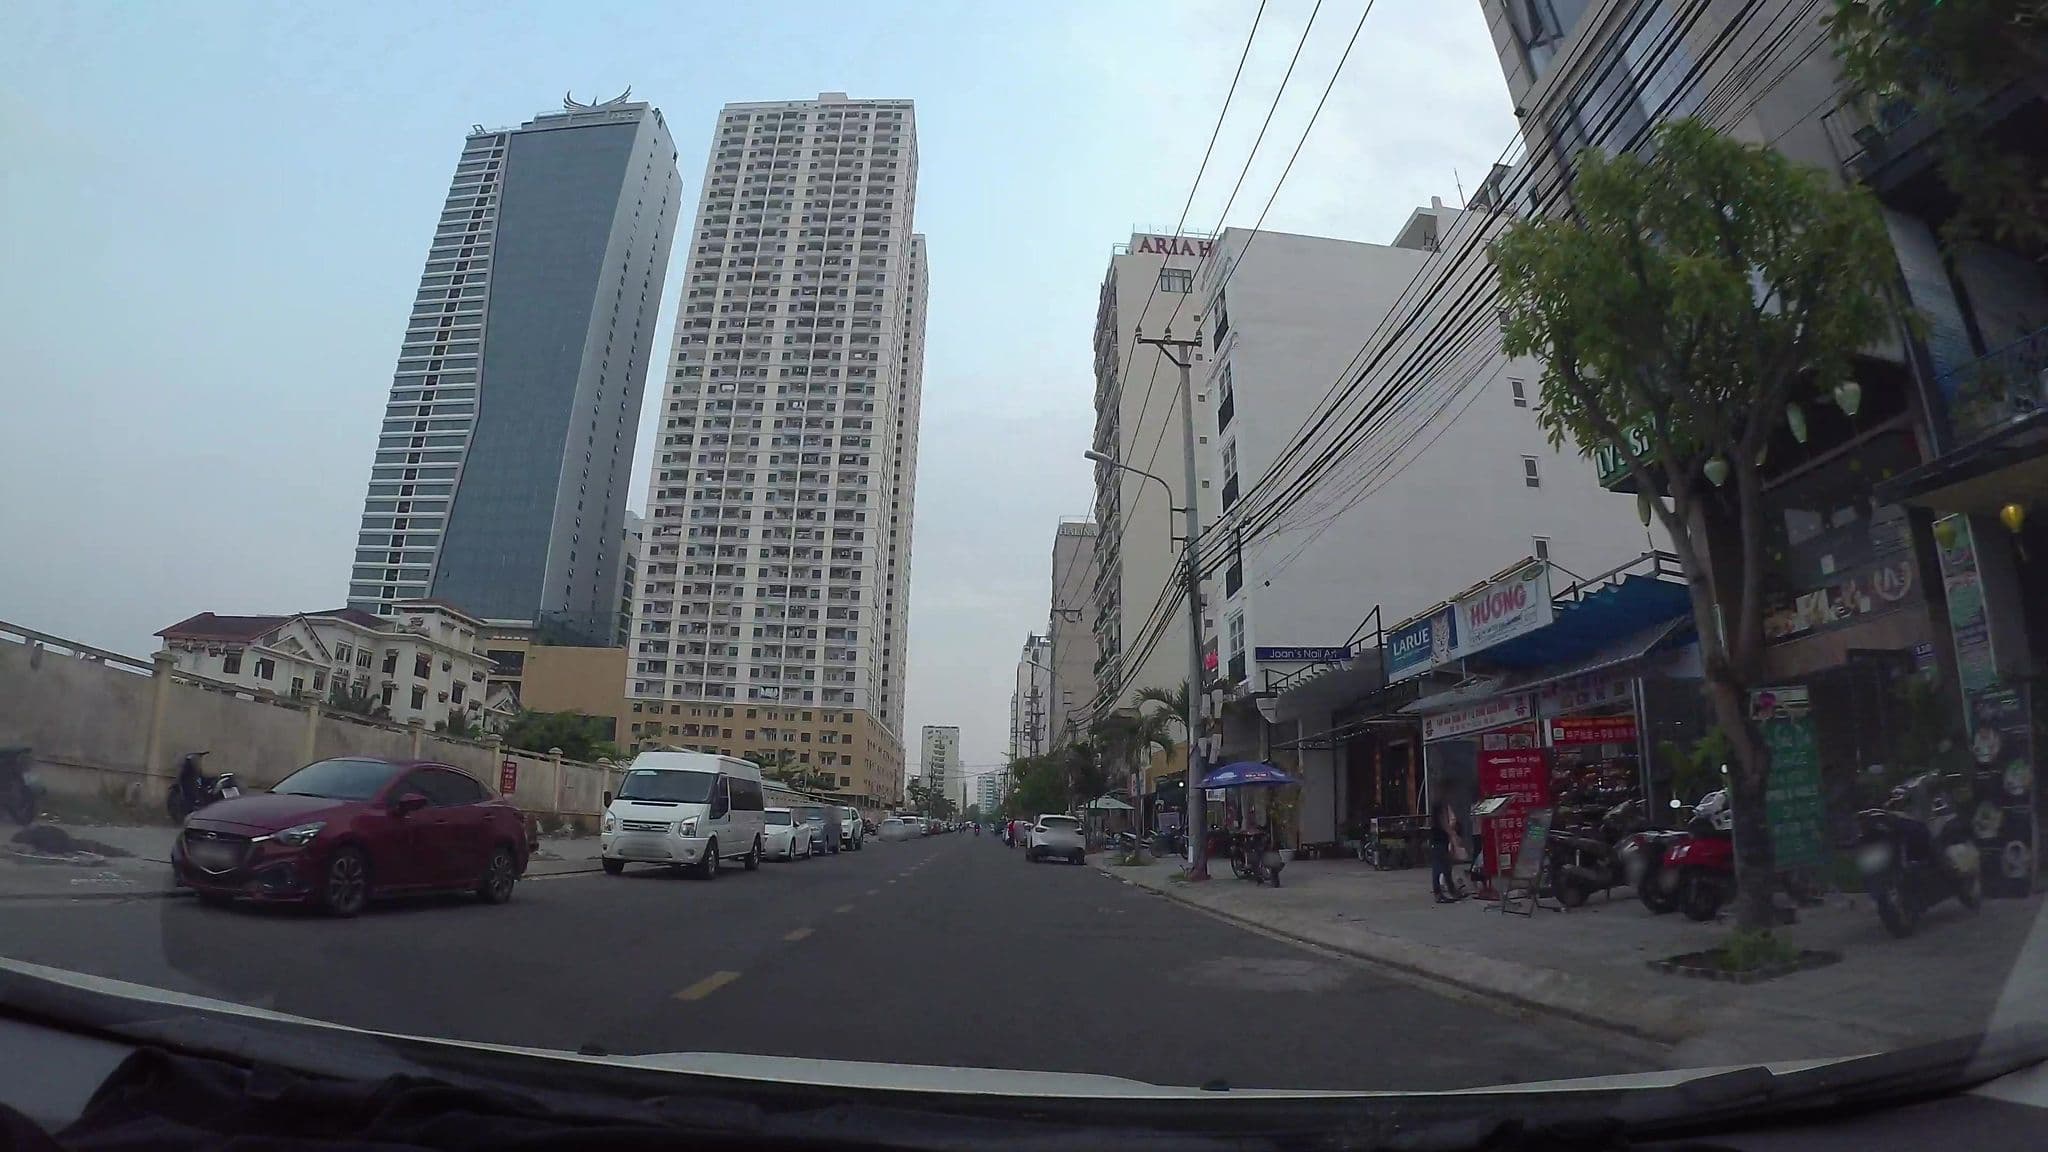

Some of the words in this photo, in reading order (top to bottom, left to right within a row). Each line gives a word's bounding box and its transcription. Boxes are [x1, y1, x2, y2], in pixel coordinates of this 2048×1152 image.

[1138, 236, 1195, 256] ARIA
[1392, 627, 1430, 656] LARUE
[1303, 649, 1322, 658] Nail
